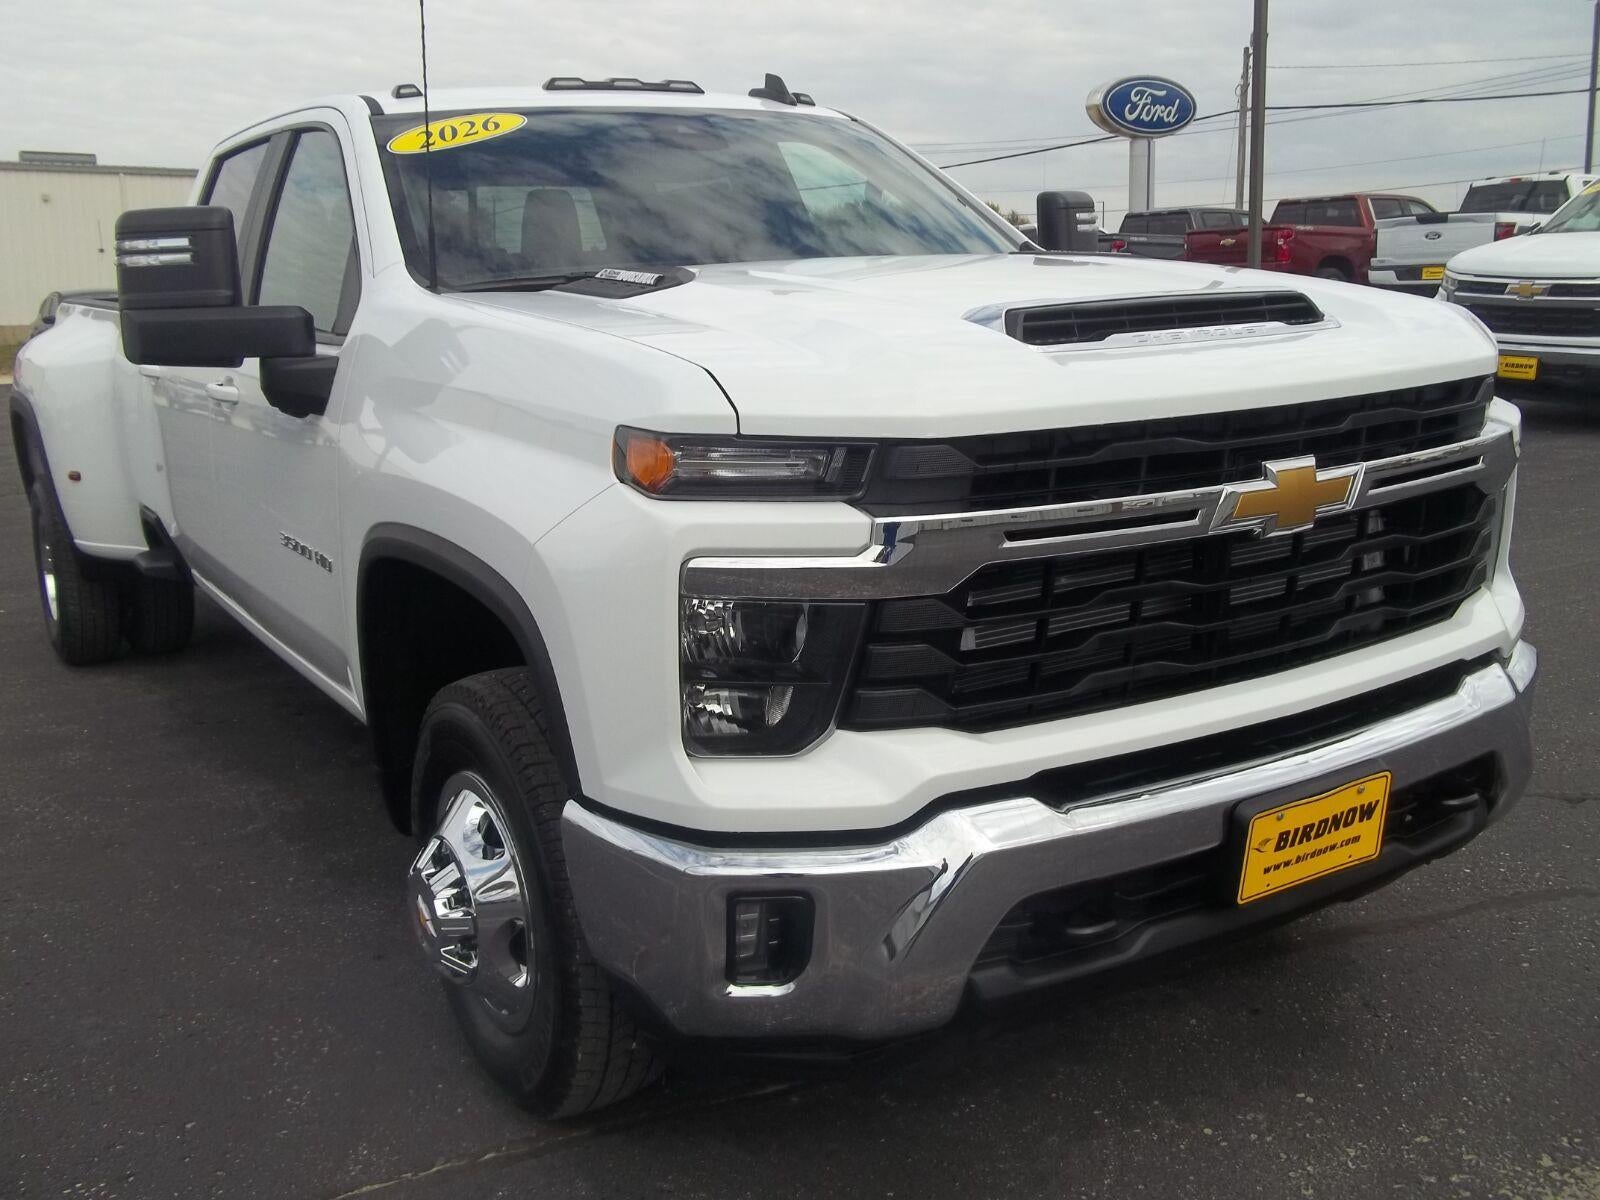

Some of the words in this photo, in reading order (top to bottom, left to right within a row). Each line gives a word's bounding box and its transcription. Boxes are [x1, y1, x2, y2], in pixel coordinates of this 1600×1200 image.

[1124, 86, 1180, 123] Ford
[416, 115, 501, 149] 2026
[1273, 799, 1380, 852] BIRDNOW
[1263, 834, 1361, 875] www.birdnow.com
